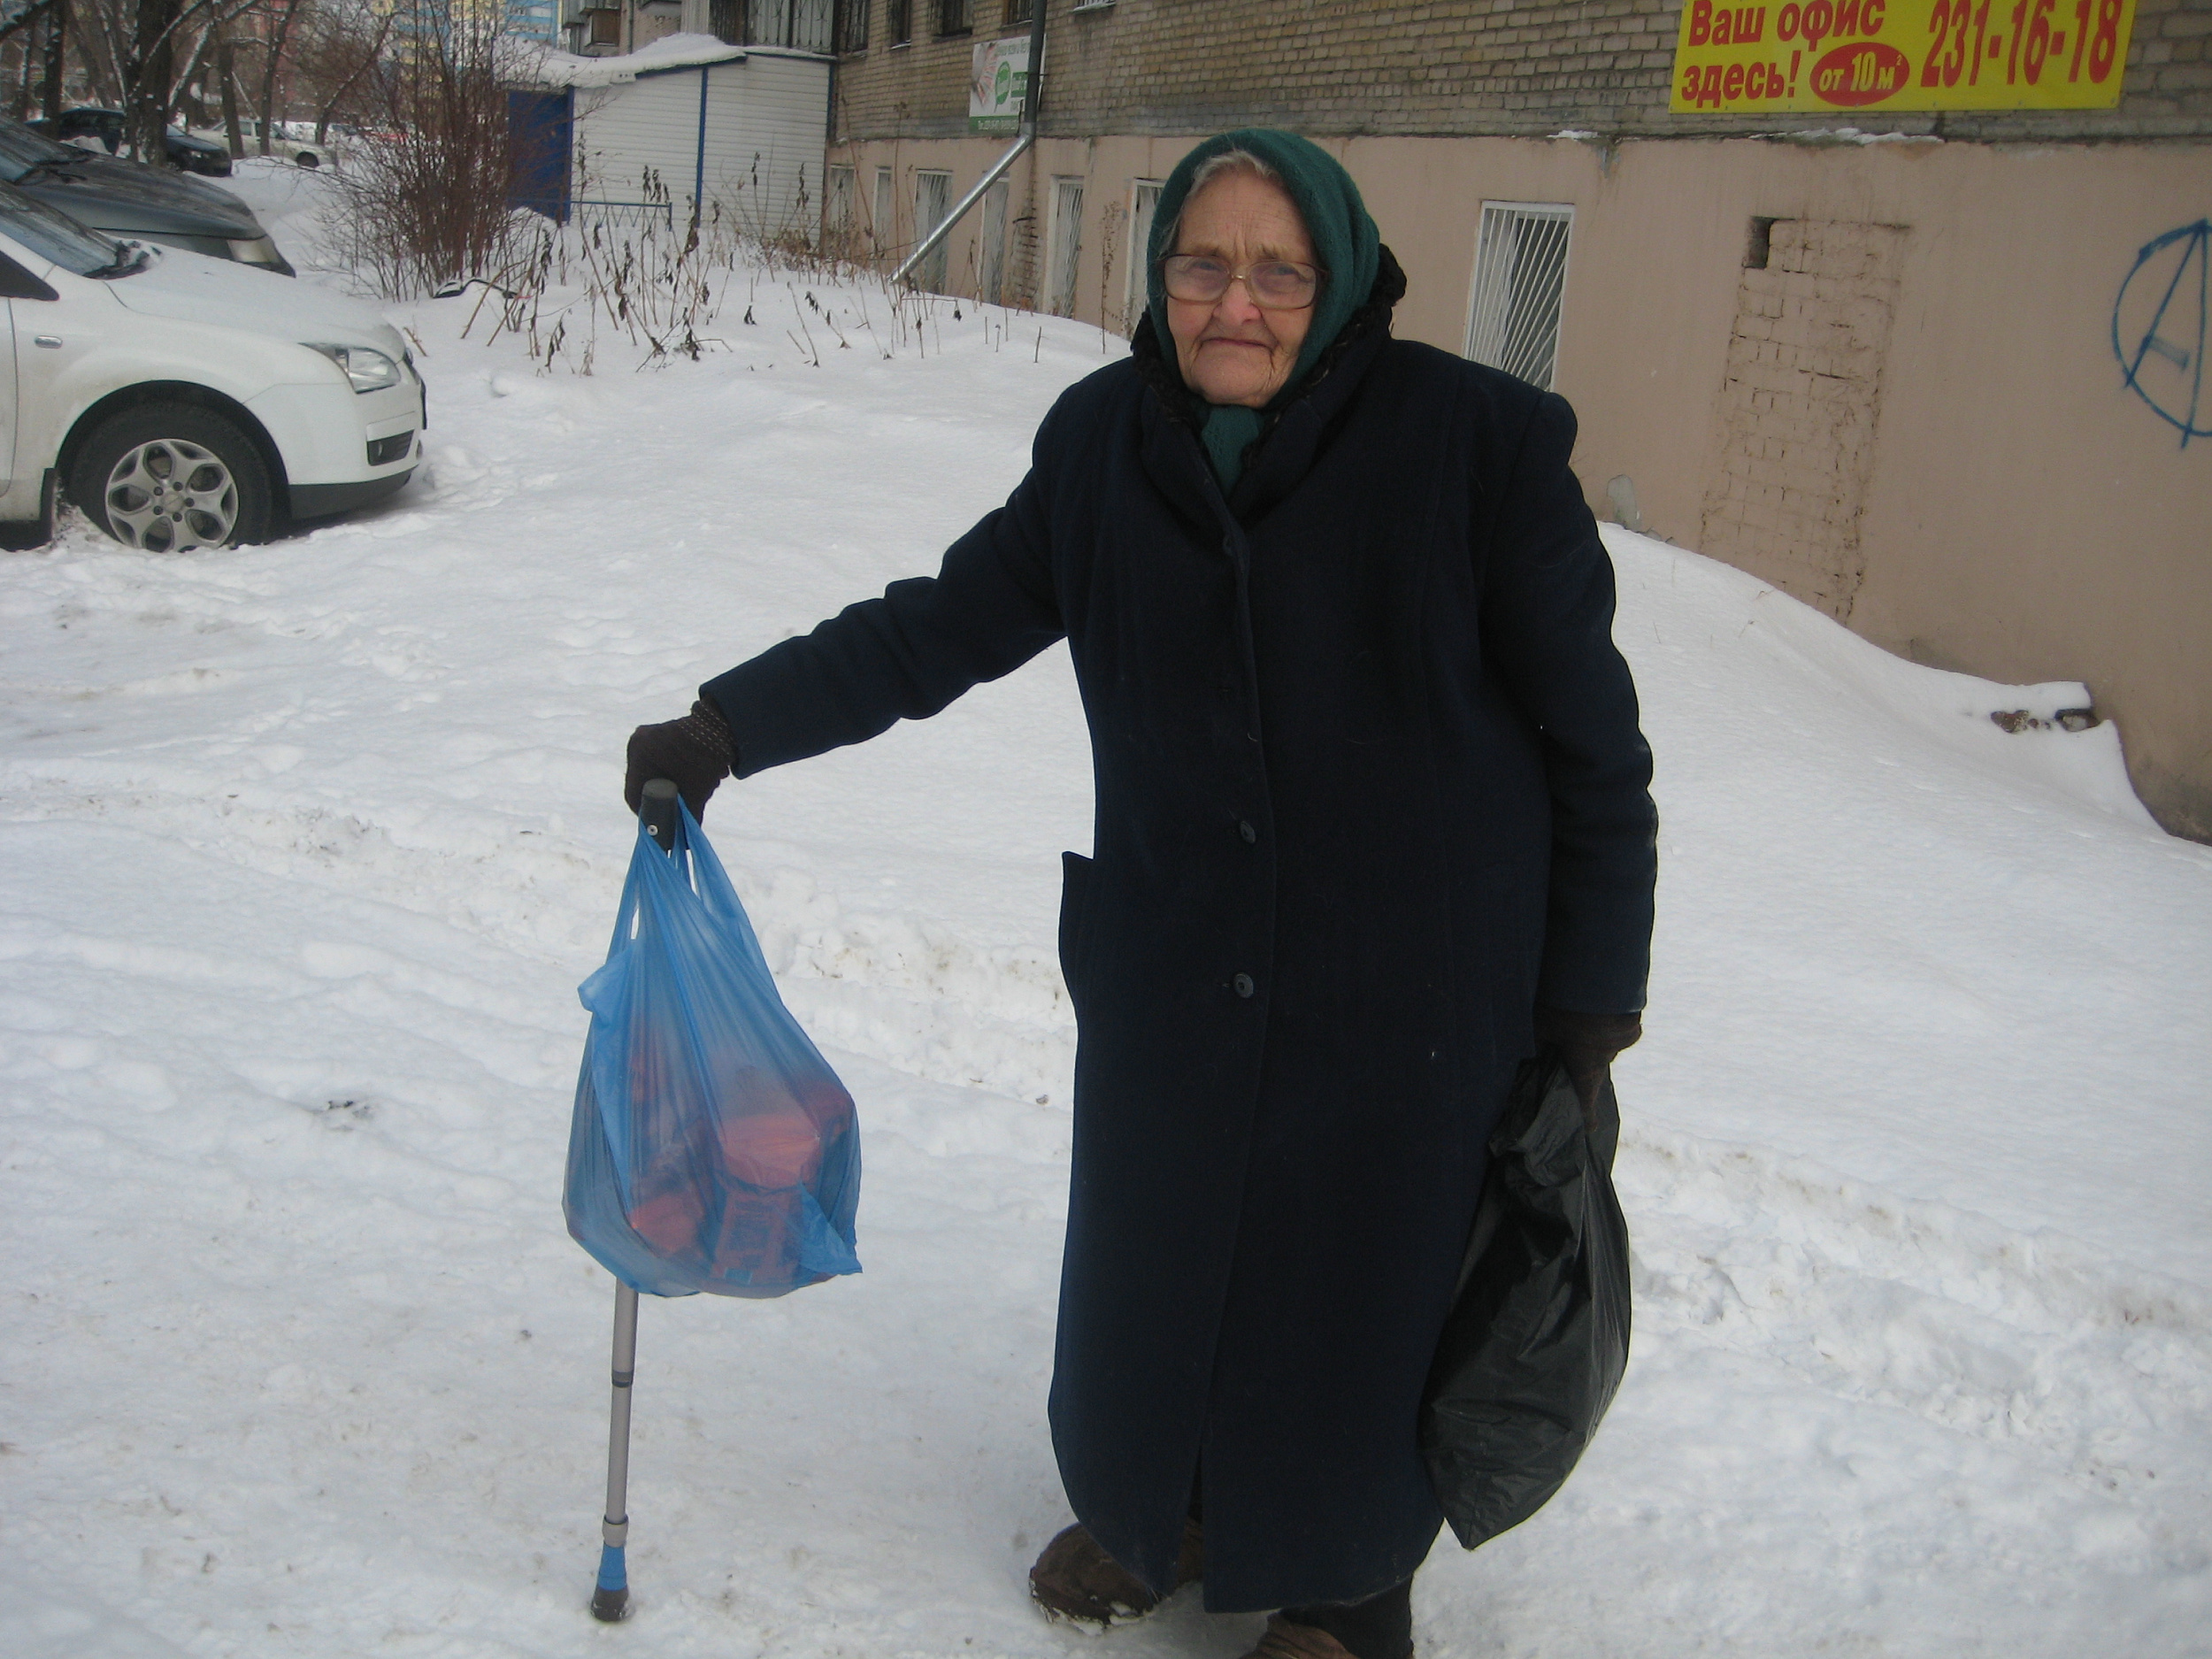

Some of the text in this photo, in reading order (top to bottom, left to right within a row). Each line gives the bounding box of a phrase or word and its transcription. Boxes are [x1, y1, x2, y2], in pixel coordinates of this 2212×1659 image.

[1689, 0, 1886, 52] Ваш офис
[1921, 0, 2124, 88] 231-16-18
[1682, 50, 1801, 108] здесь!
[1818, 68, 1845, 91] от
